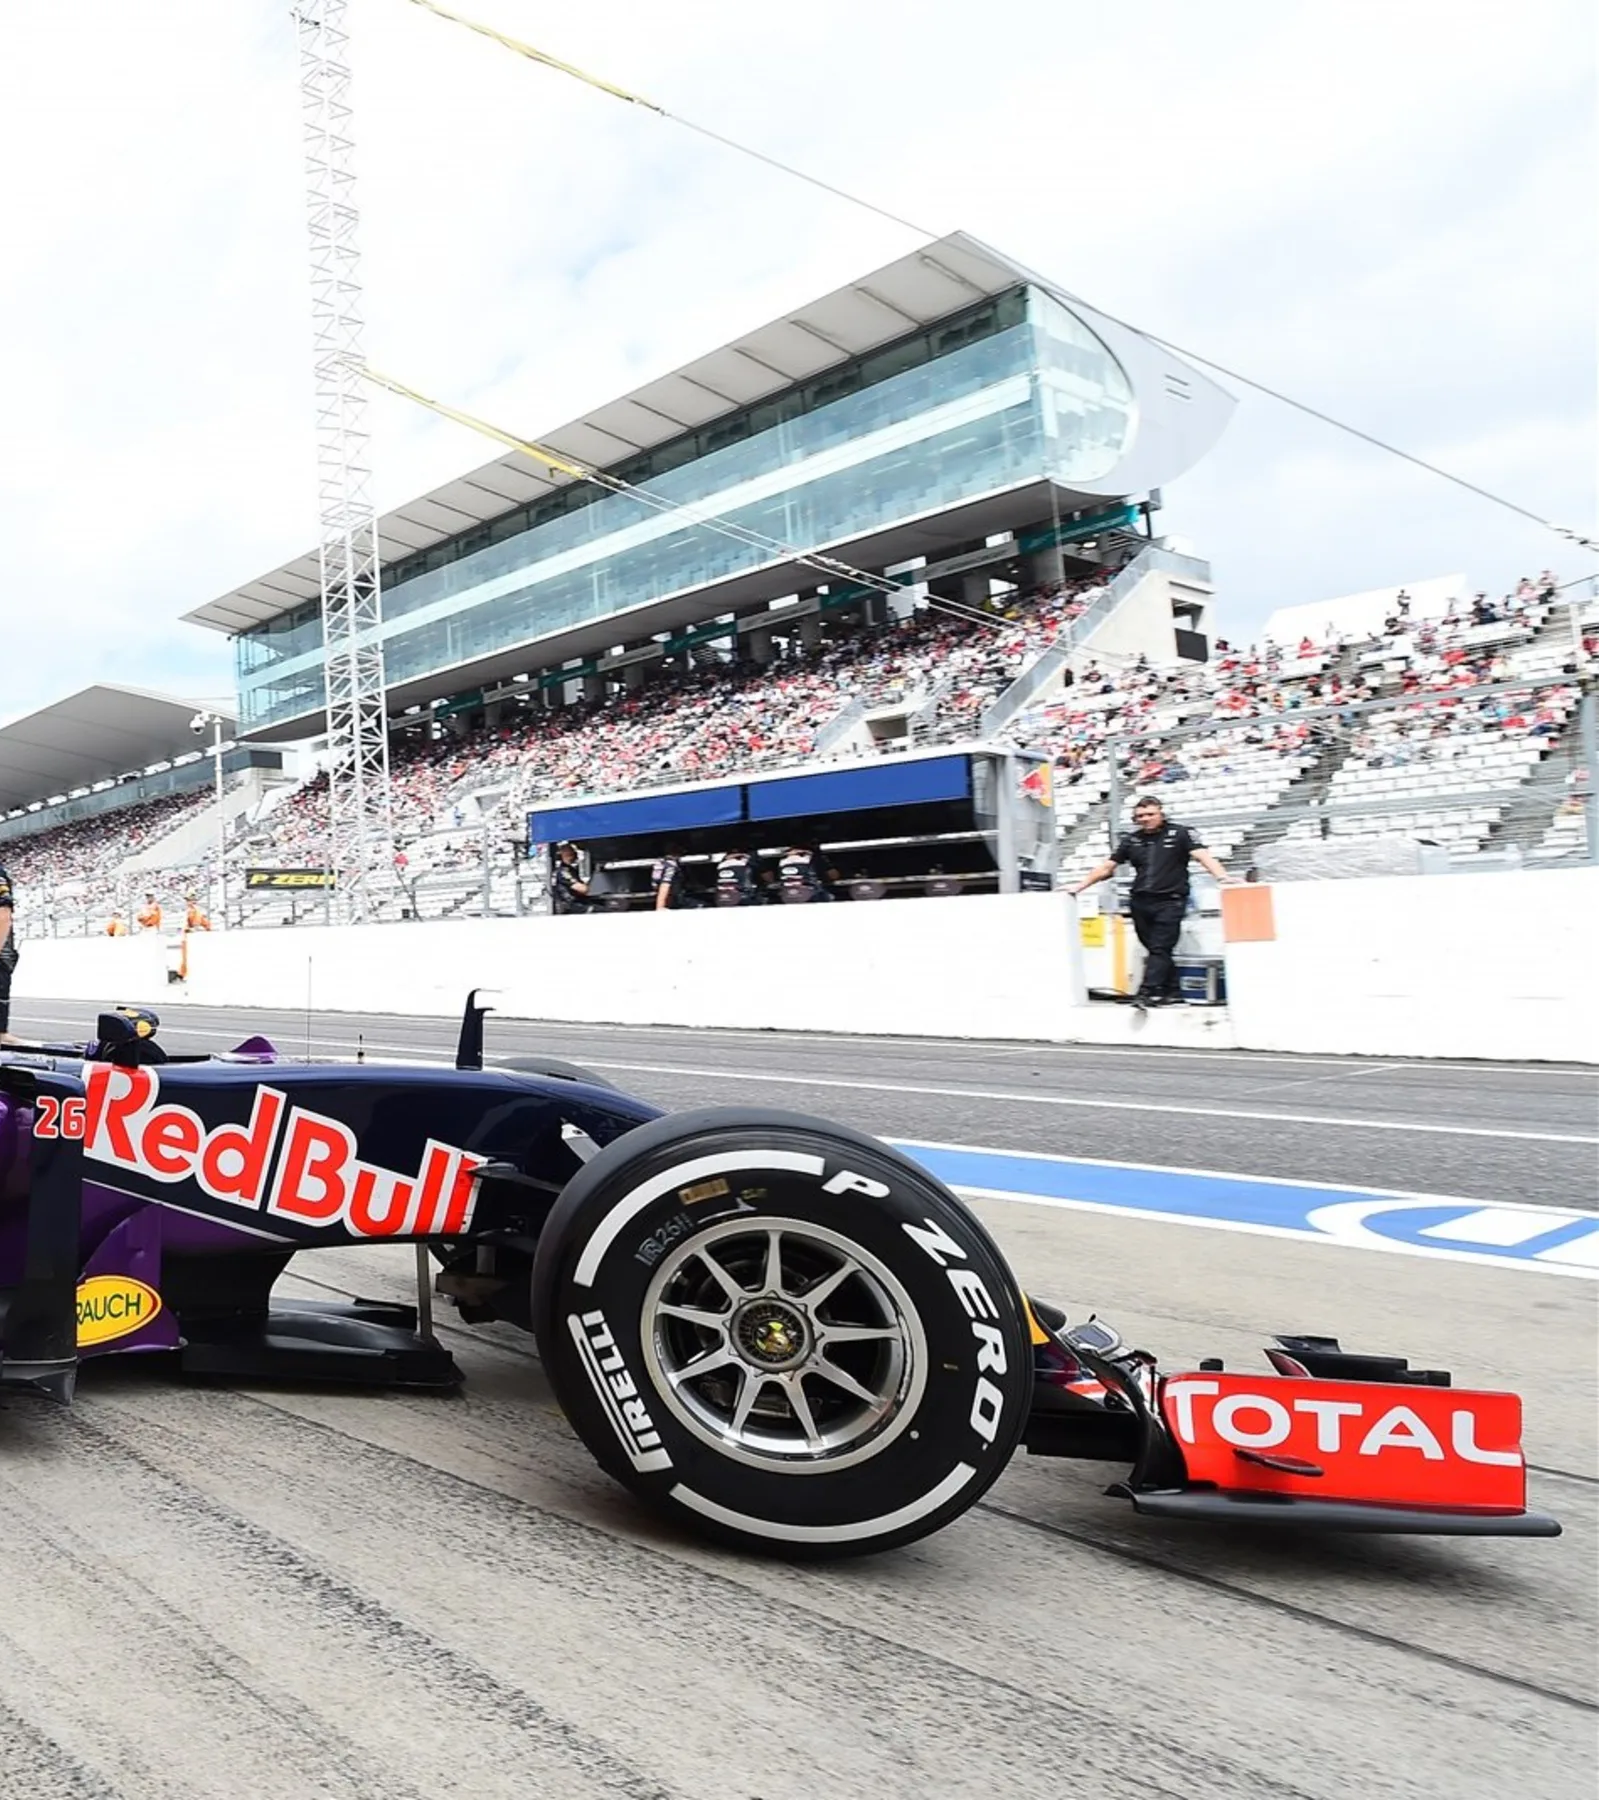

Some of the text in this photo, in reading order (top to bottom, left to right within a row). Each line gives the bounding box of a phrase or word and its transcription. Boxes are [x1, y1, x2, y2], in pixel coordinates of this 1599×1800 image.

[249, 873, 269, 885] P
[34, 1097, 86, 1139] 26
[821, 1169, 1008, 1446] P ZERO
[568, 1310, 675, 1473] PIRELLI
[1164, 1380, 1523, 1467] TOTAL
